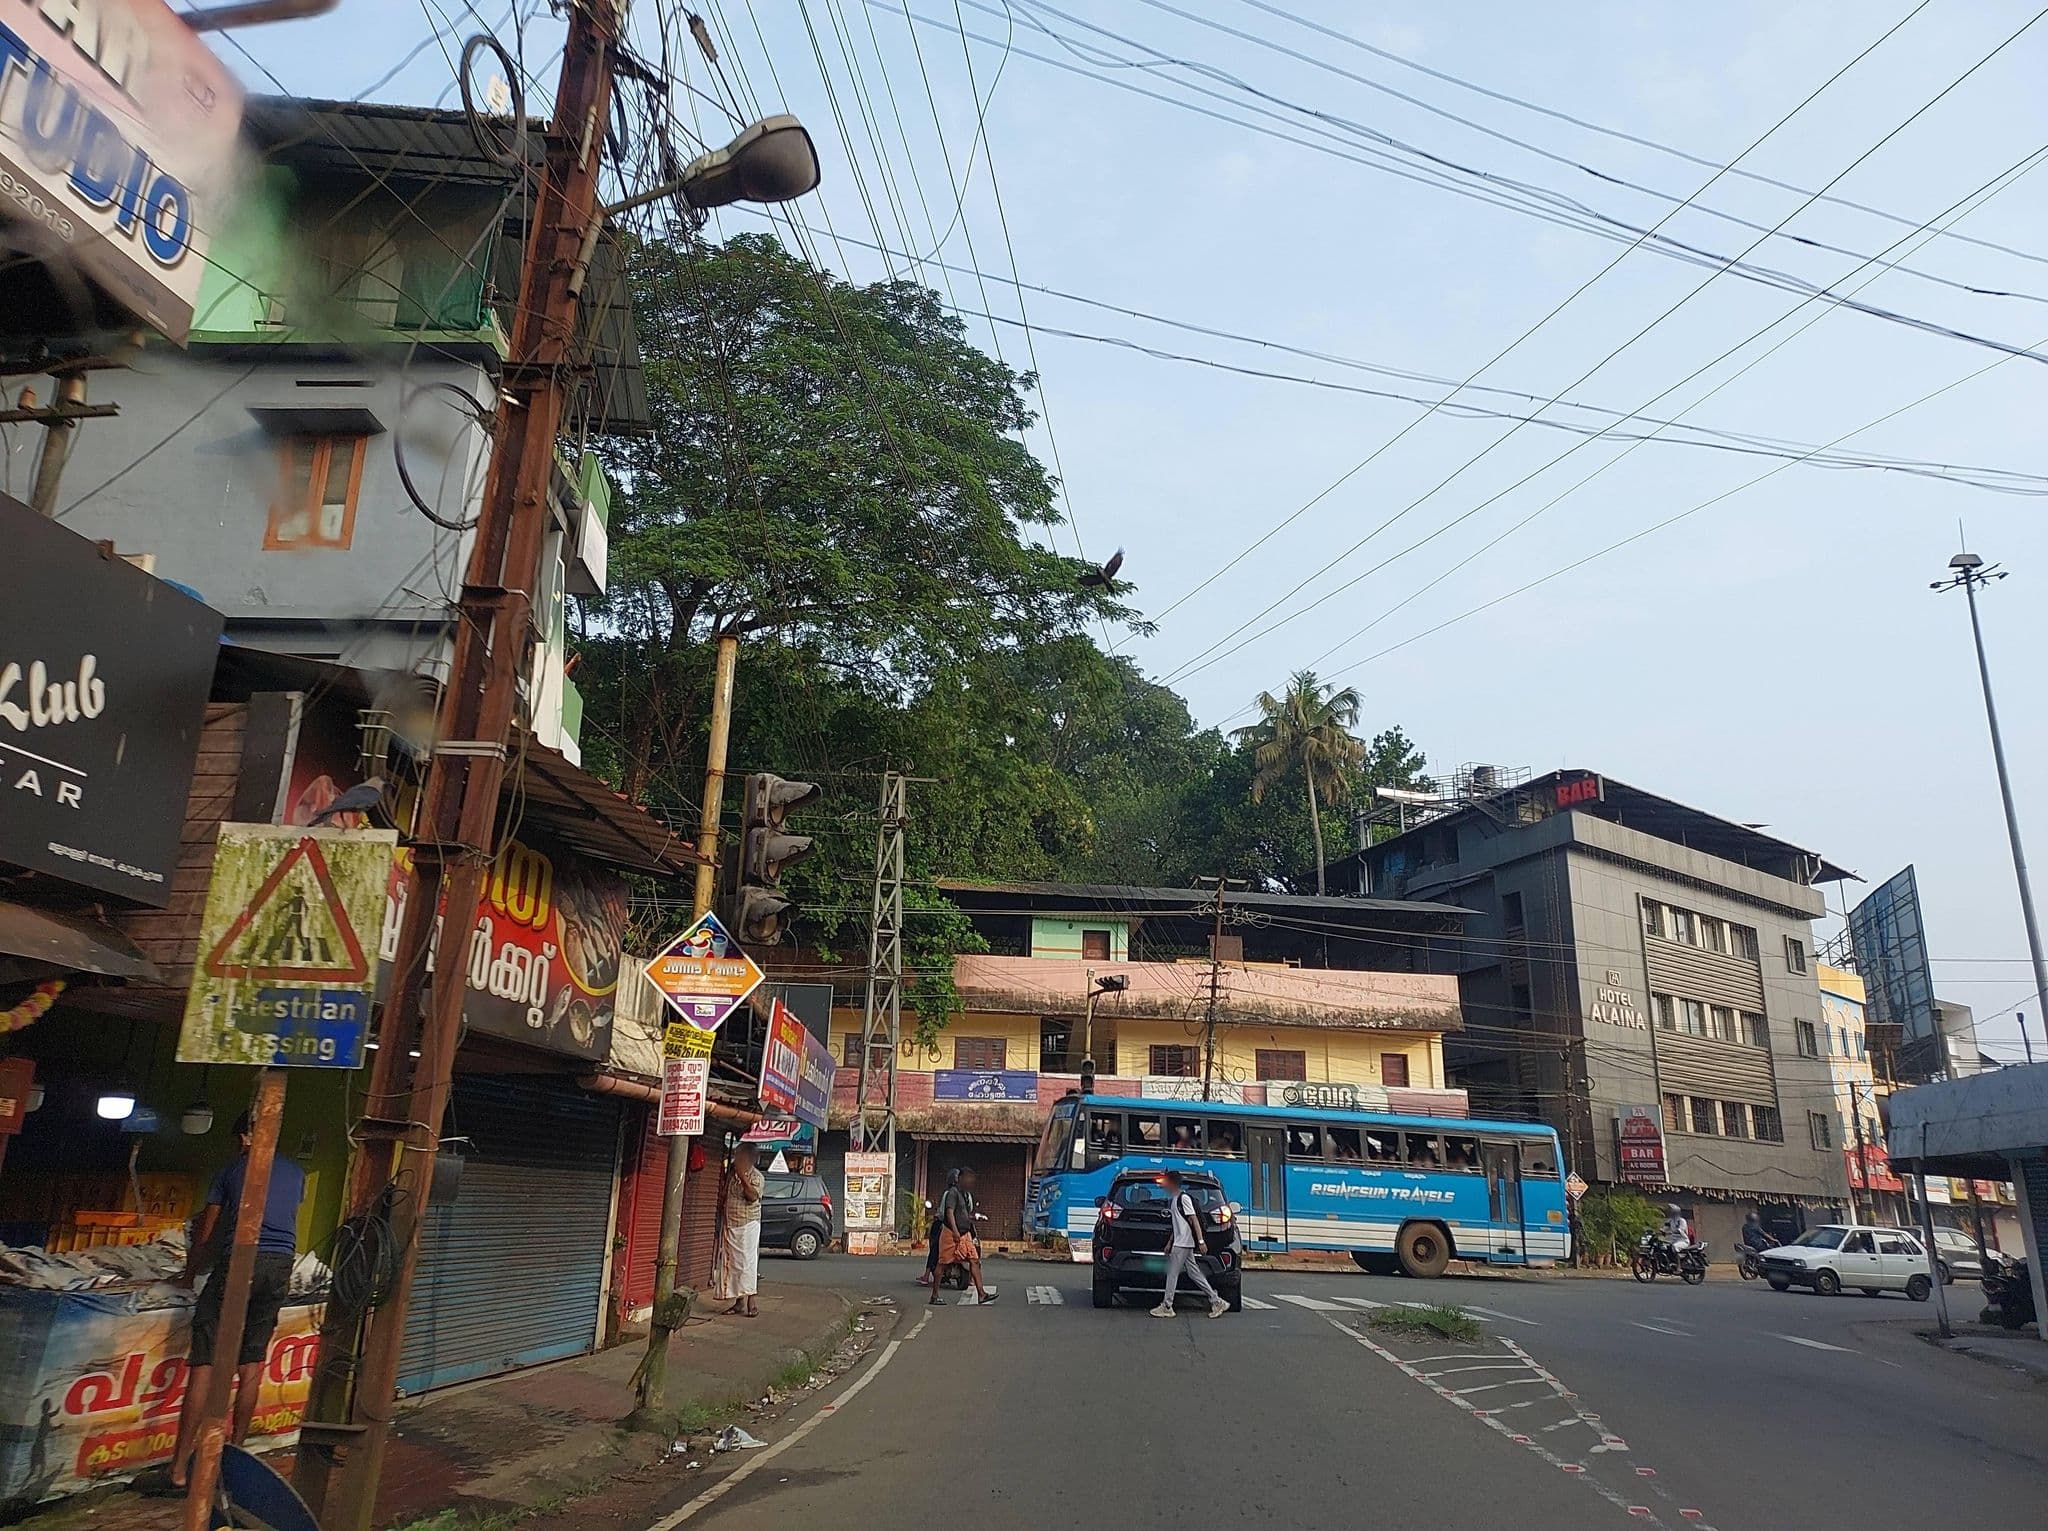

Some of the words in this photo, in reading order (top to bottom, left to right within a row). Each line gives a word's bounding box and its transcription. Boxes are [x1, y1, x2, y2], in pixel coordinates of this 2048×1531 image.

[0, 757, 84, 811] AR
[1555, 778, 1597, 807] BAR
[1599, 987, 1634, 1007] HOTEL
[1591, 1003, 1647, 1031] ALAINA
[1630, 1149, 1655, 1159] BAR
[1391, 1185, 1456, 1206] TRAVELS
